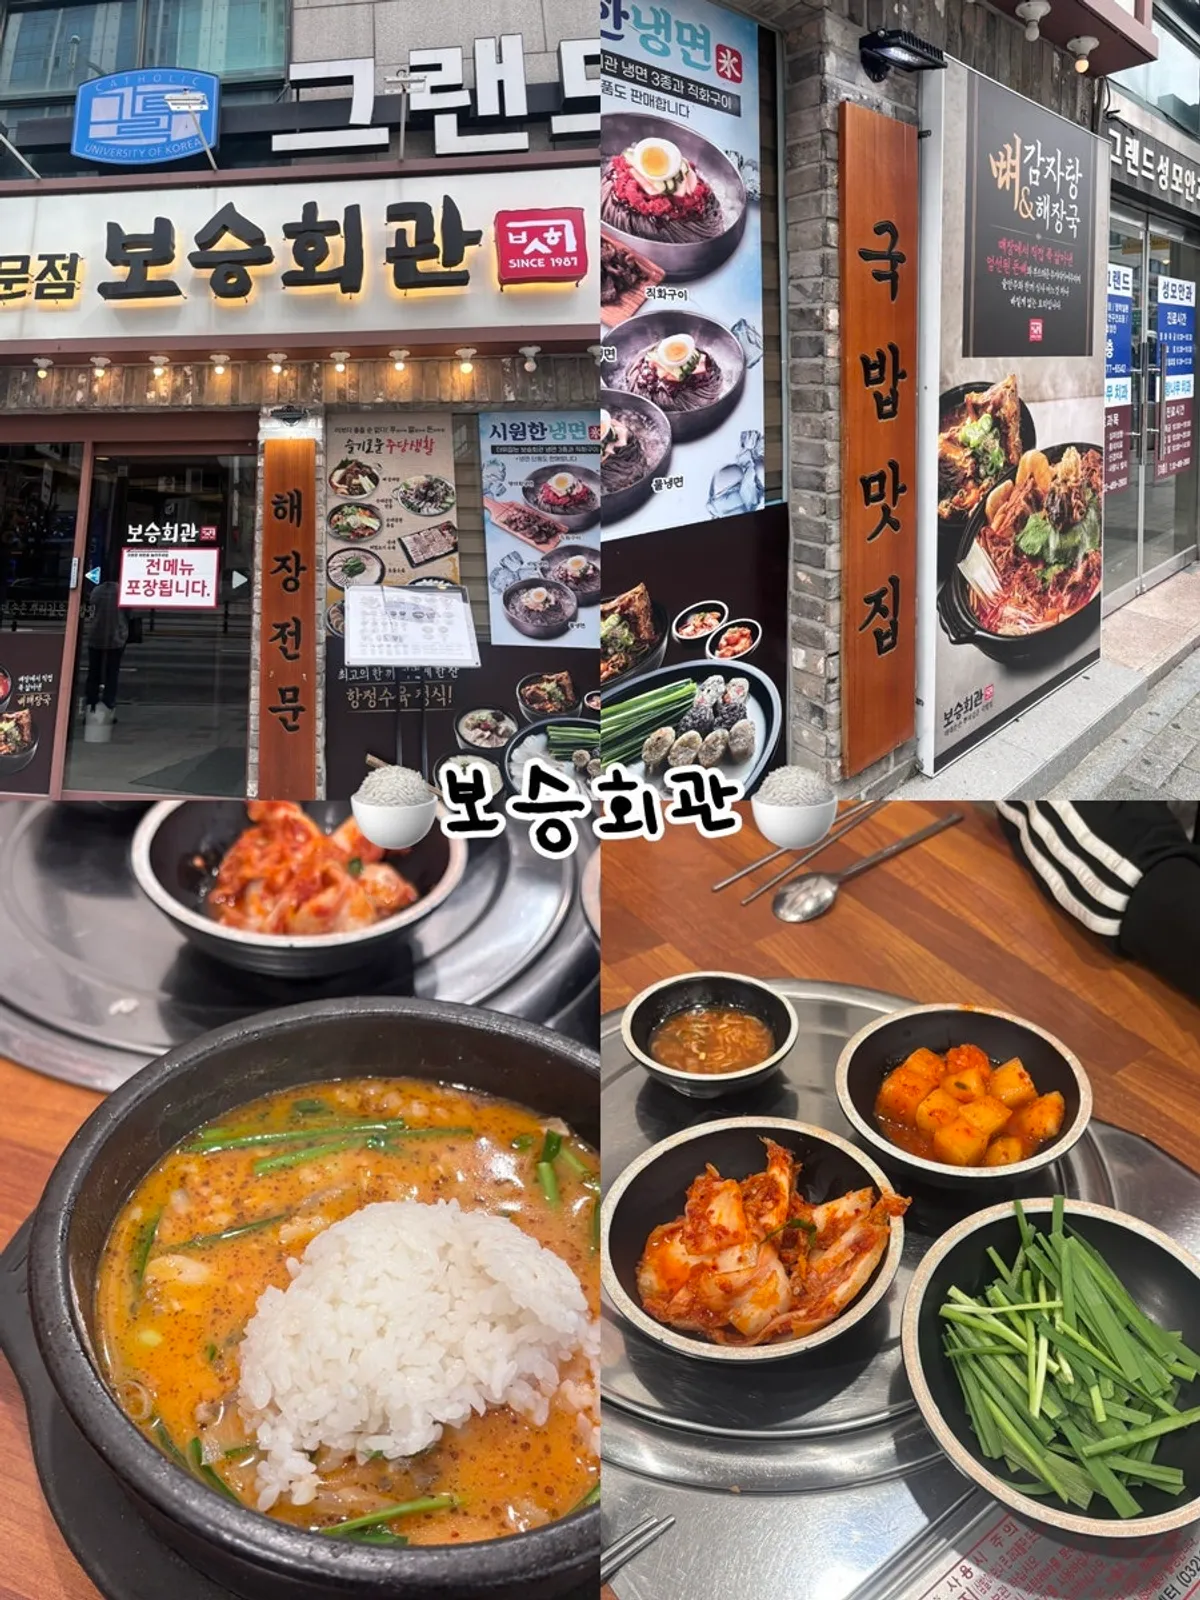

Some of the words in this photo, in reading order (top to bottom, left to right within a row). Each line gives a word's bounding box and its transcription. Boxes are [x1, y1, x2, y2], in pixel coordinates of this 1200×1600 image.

[631, 4, 712, 72] 냉면
[95, 74, 200, 92] CATHOLIC
[601, 54, 619, 74] 관
[621, 60, 648, 83] 냉면
[651, 70, 685, 95] 3종과
[687, 82, 732, 110] 직화구이
[630, 88, 691, 118] 판매합니다
[84, 142, 147, 159] UNIVERSITY
[148, 146, 163, 157] OF
[165, 138, 202, 155] KOREA
[1023, 139, 1083, 200] 감자탕
[1108, 127, 1200, 203] 그랜드성모안
[1035, 193, 1082, 239] 해장국
[97, 194, 482, 300] 보승회관
[508, 258, 546, 269] SINCE
[549, 256, 578, 268] 1987
[646, 287, 688, 301] 직화구이
[1162, 281, 1193, 303] 성모안과
[489, 420, 548, 441] 시원한
[548, 420, 587, 440] 냉면
[858, 219, 908, 658] 국밥맛집
[652, 476, 684, 492] 물냉면
[126, 521, 200, 544] 보승회관
[145, 558, 195, 576] 전메뉴
[125, 579, 210, 598] 포장됩니다.
[268, 488, 307, 733] 해장전문
[943, 688, 985, 728] 보승회관
